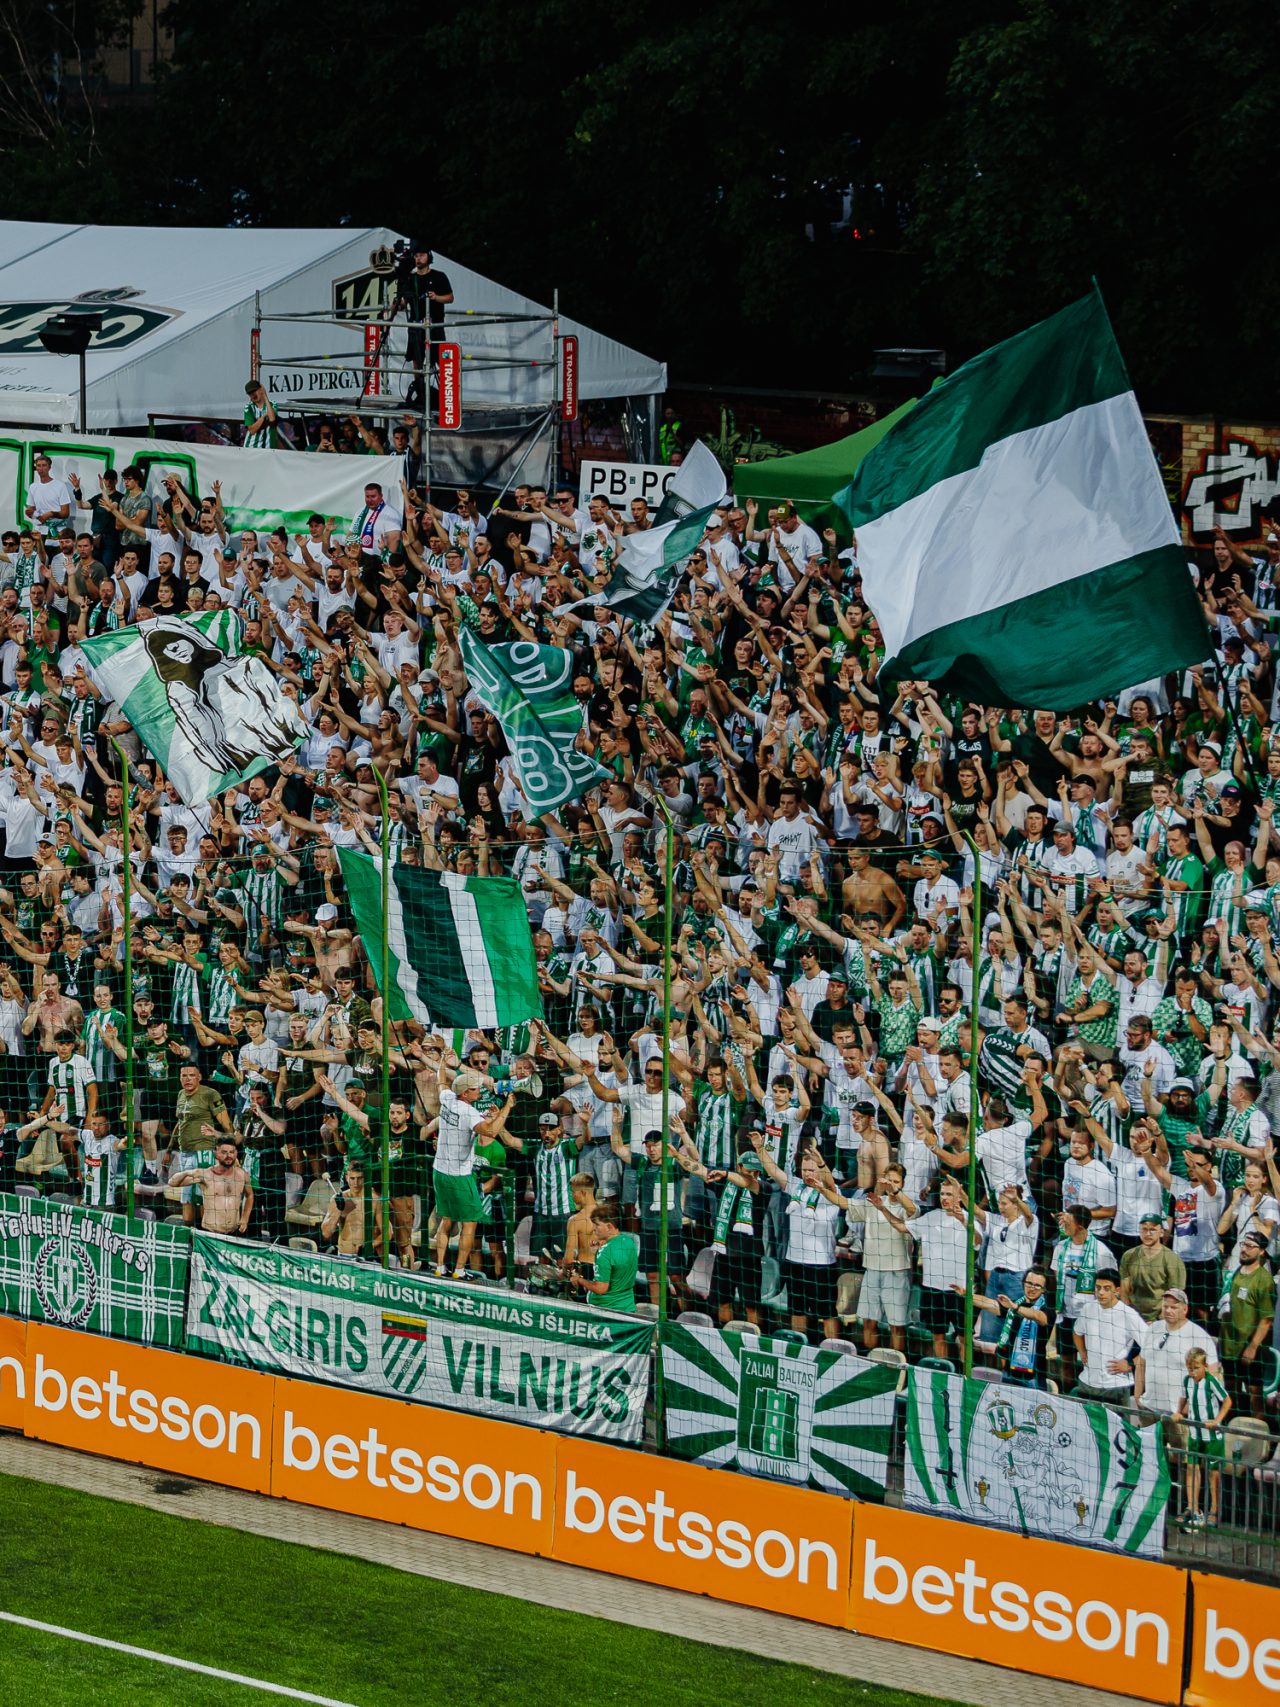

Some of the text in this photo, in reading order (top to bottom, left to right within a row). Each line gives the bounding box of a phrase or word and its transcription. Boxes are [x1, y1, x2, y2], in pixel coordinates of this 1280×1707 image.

[268, 374, 305, 393] KAD
[444, 357, 454, 425] TRANSRIFUS
[590, 467, 627, 495] PB
[51, 1211, 73, 1238] IV
[80, 1217, 150, 1273] Ultras
[373, 1280, 427, 1304] MŪSŲ
[431, 1289, 534, 1328] TIKĖJIMAS
[539, 1311, 614, 1343] IŠLIEKA
[442, 1335, 632, 1424] VILNIUS
[745, 1357, 814, 1388] ŽALIAI BALTAS
[34, 1353, 262, 1459] betsson
[283, 1410, 542, 1521] betsson
[1113, 1428, 1141, 1470] 9
[565, 1470, 838, 1591] betsson
[1111, 1480, 1138, 1526] 7
[863, 1539, 1170, 1665] betsson
